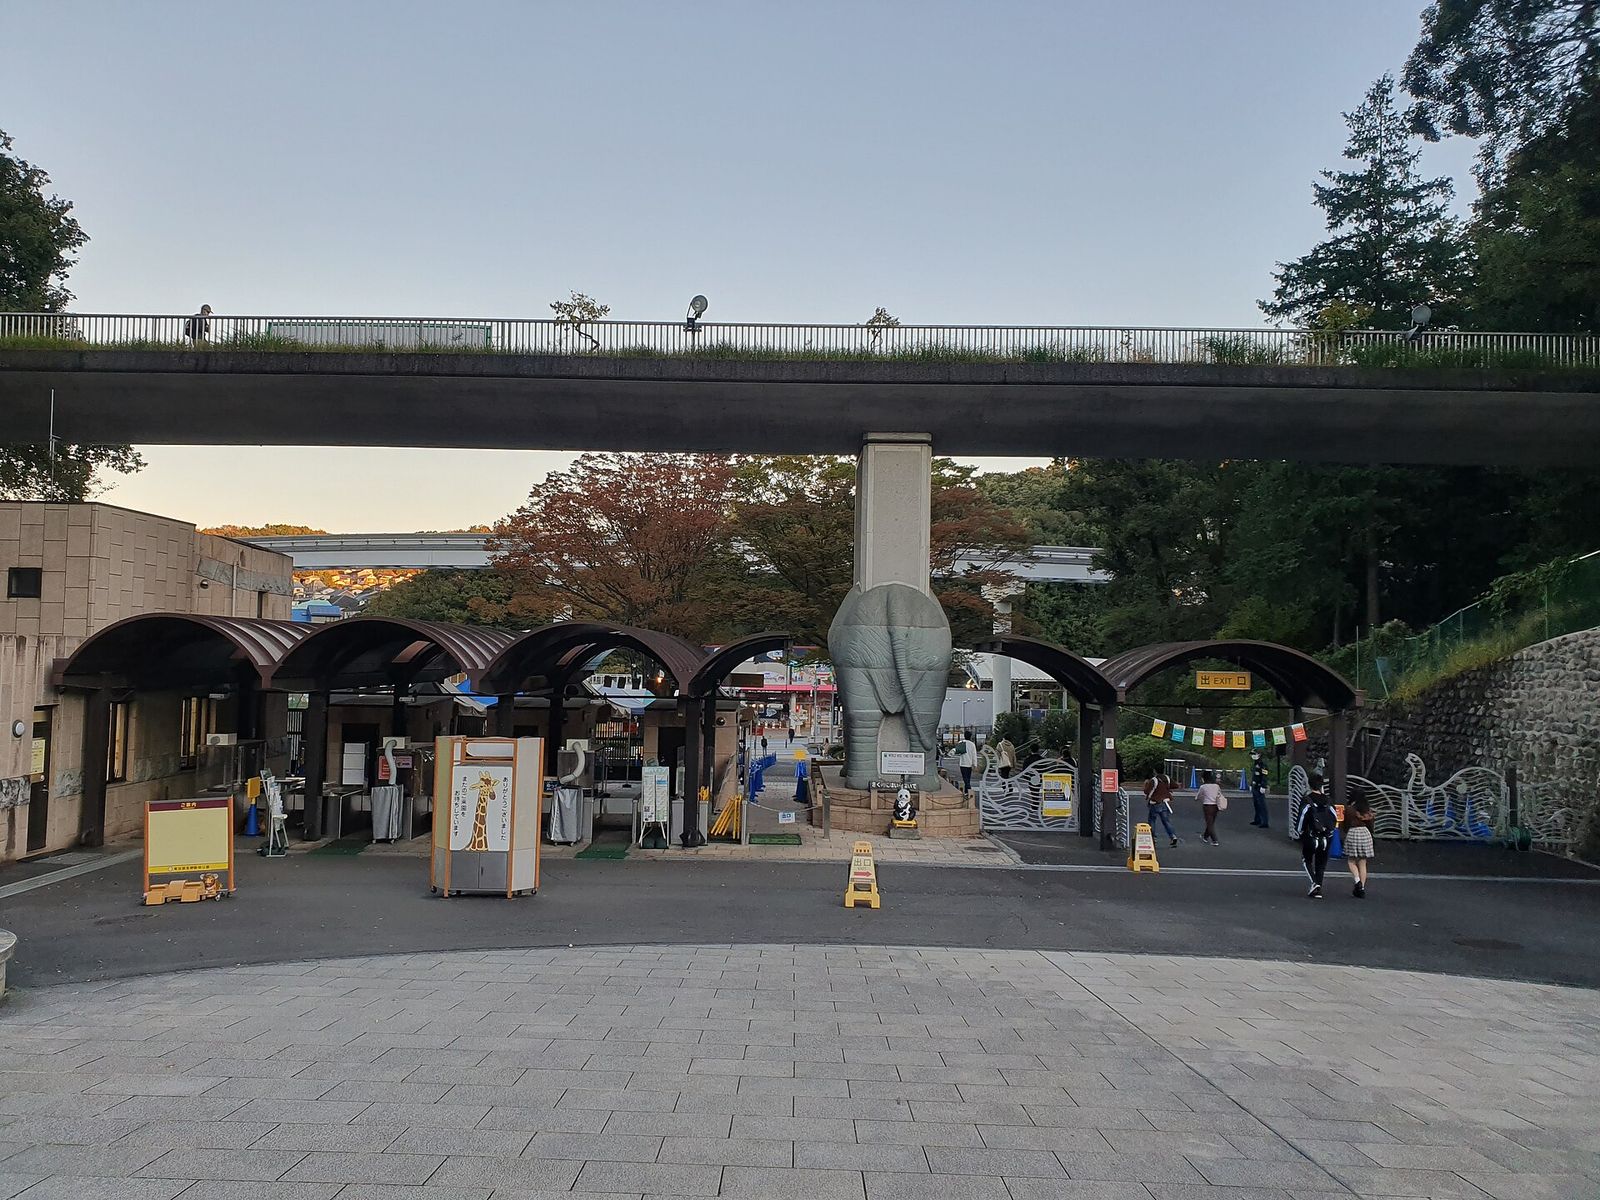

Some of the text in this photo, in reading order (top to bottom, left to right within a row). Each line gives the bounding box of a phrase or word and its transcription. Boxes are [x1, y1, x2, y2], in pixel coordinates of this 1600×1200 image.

[1200, 675, 1209, 685] 出
[1237, 676, 1246, 685] 口
[501, 777, 509, 841] ありがとうございました
[854, 858, 871, 866] 出口
